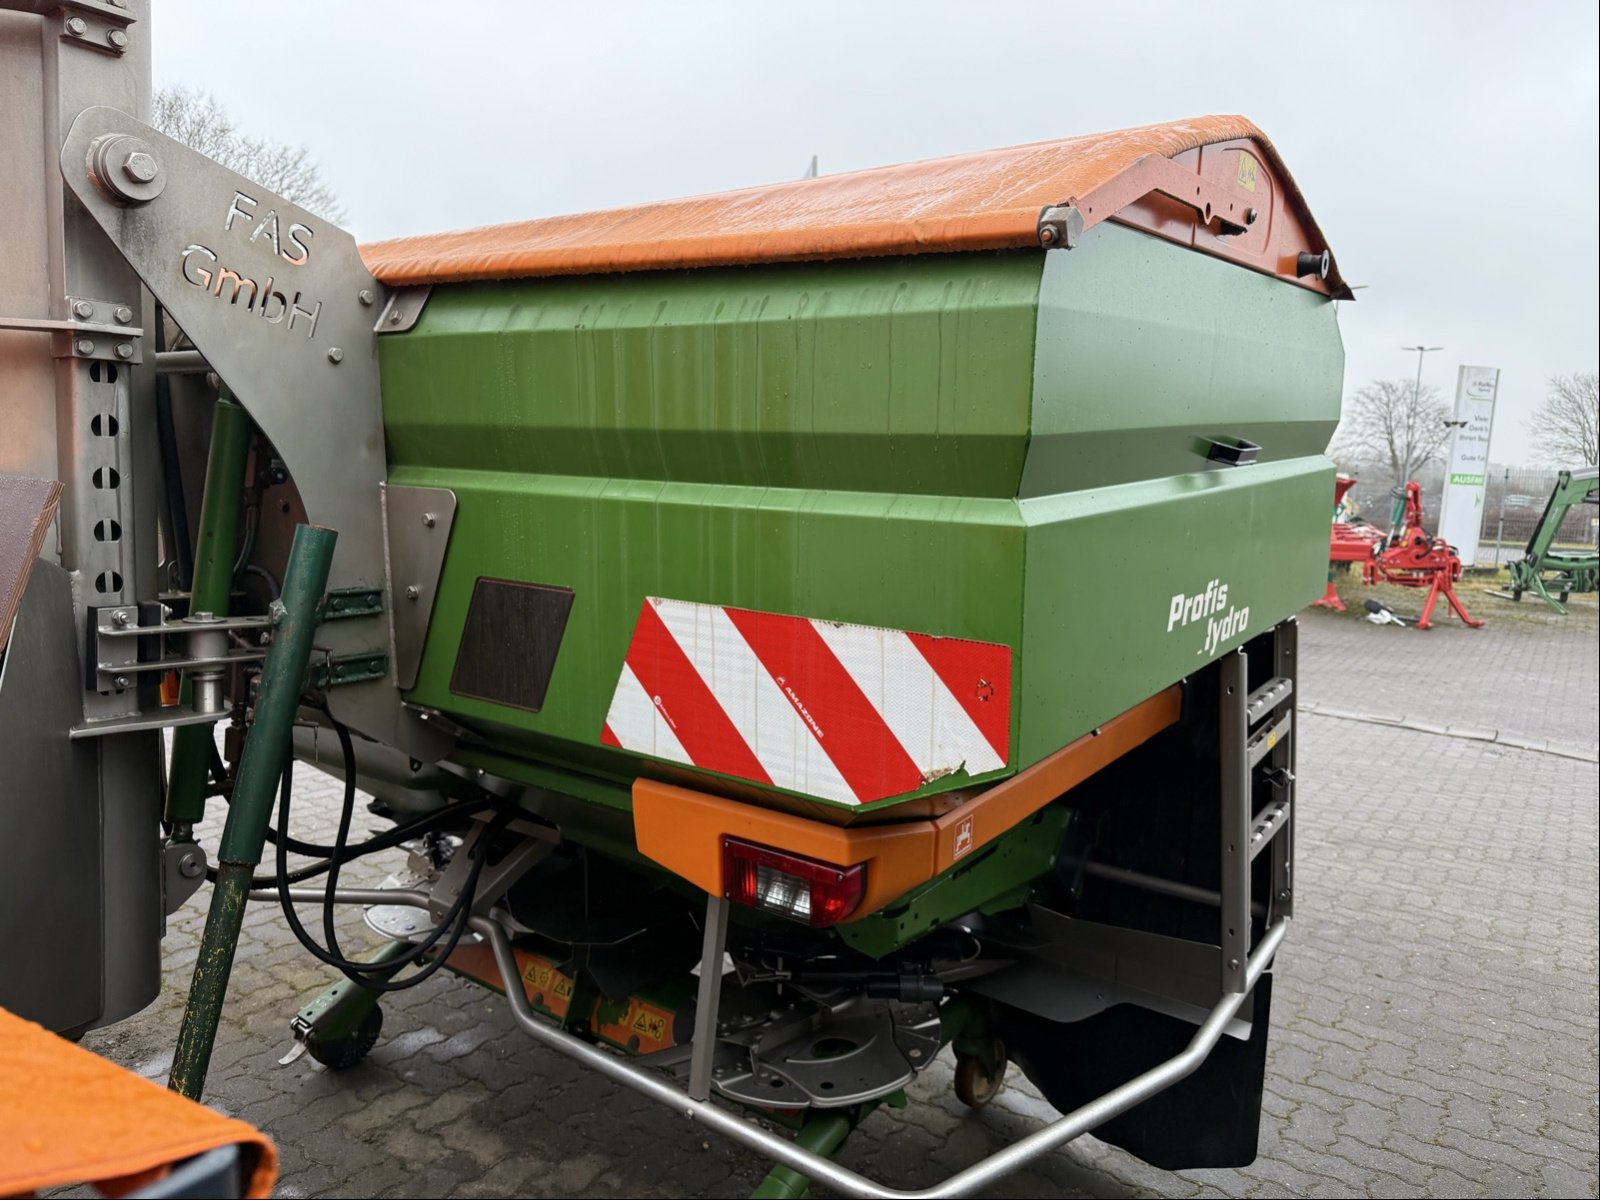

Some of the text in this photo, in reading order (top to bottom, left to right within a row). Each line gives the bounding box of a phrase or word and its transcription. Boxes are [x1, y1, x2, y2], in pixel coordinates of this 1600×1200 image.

[225, 190, 314, 266] FAS
[181, 244, 322, 340] GmbH
[1166, 578, 1229, 633] Profis
[785, 687, 824, 738] AMAZONE
